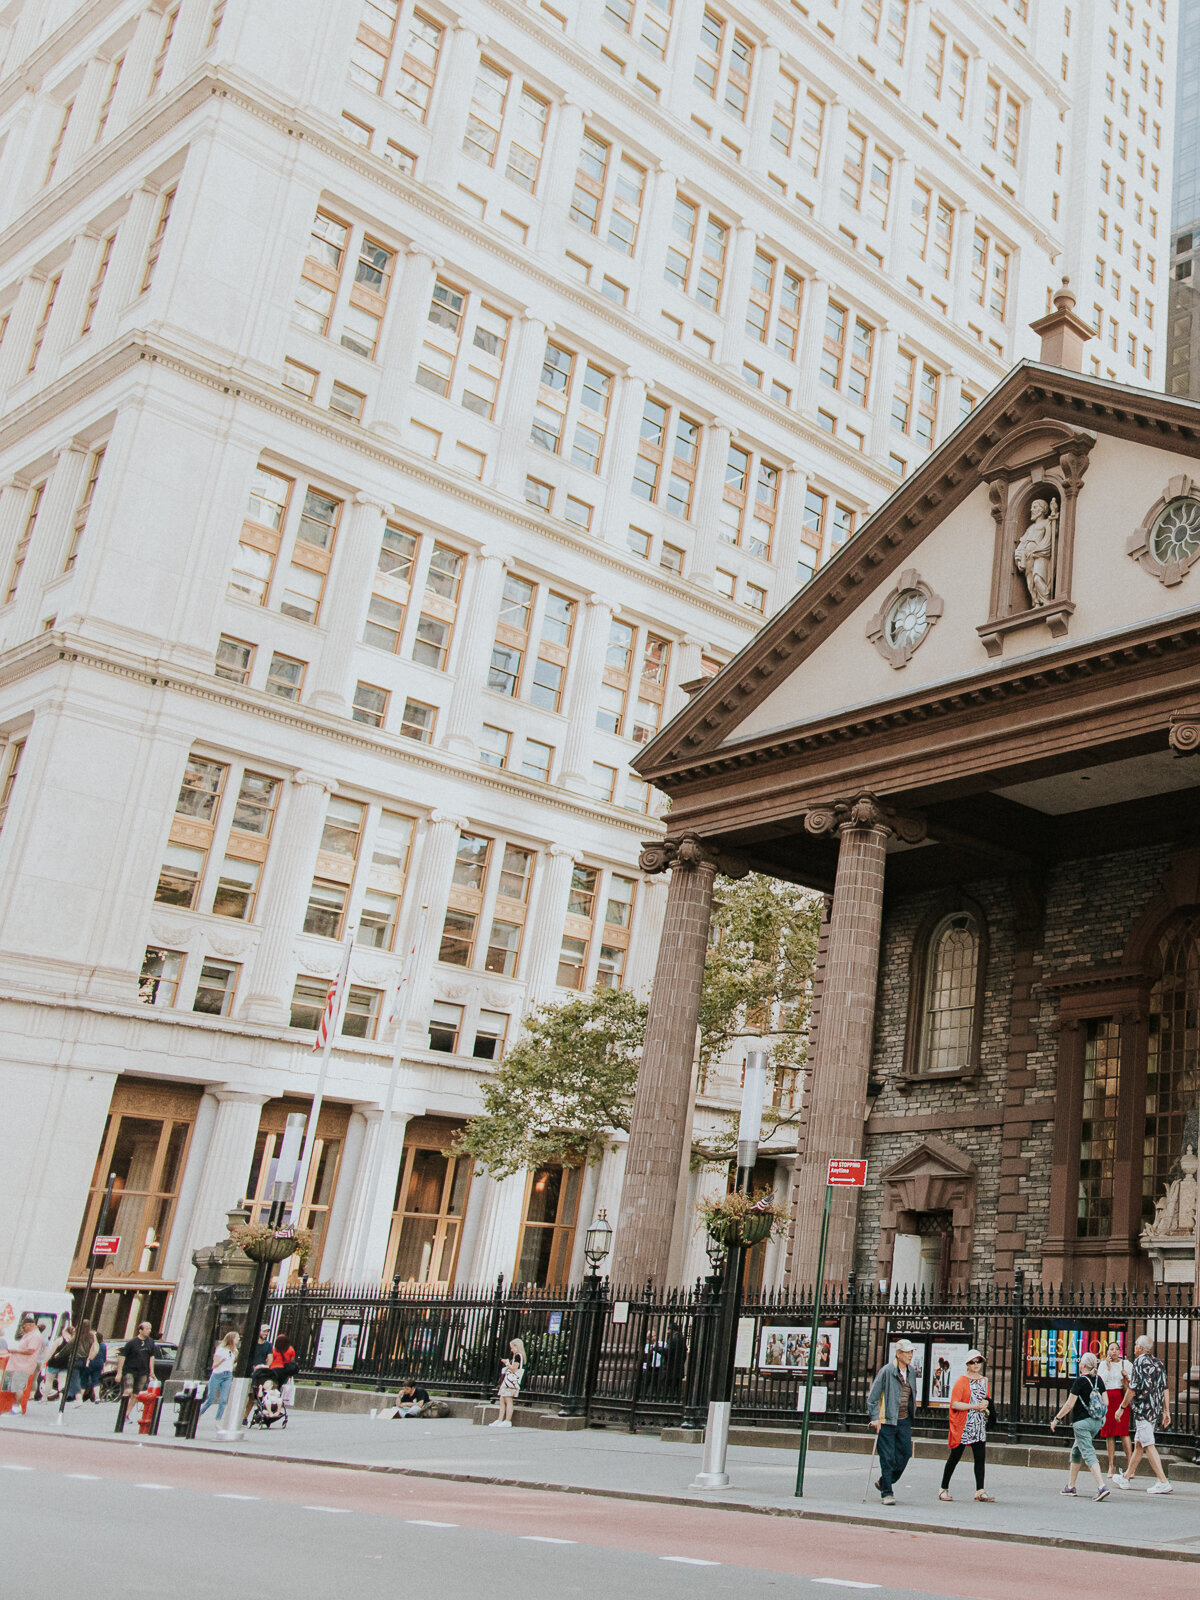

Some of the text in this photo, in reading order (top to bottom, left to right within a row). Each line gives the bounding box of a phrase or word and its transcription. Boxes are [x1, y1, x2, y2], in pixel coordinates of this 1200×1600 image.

[906, 1320, 931, 1329] PAUL'S
[933, 1321, 965, 1330] CHAPEL
[1027, 1338, 1063, 1355] PIPES
[1067, 1338, 1083, 1355] AT
